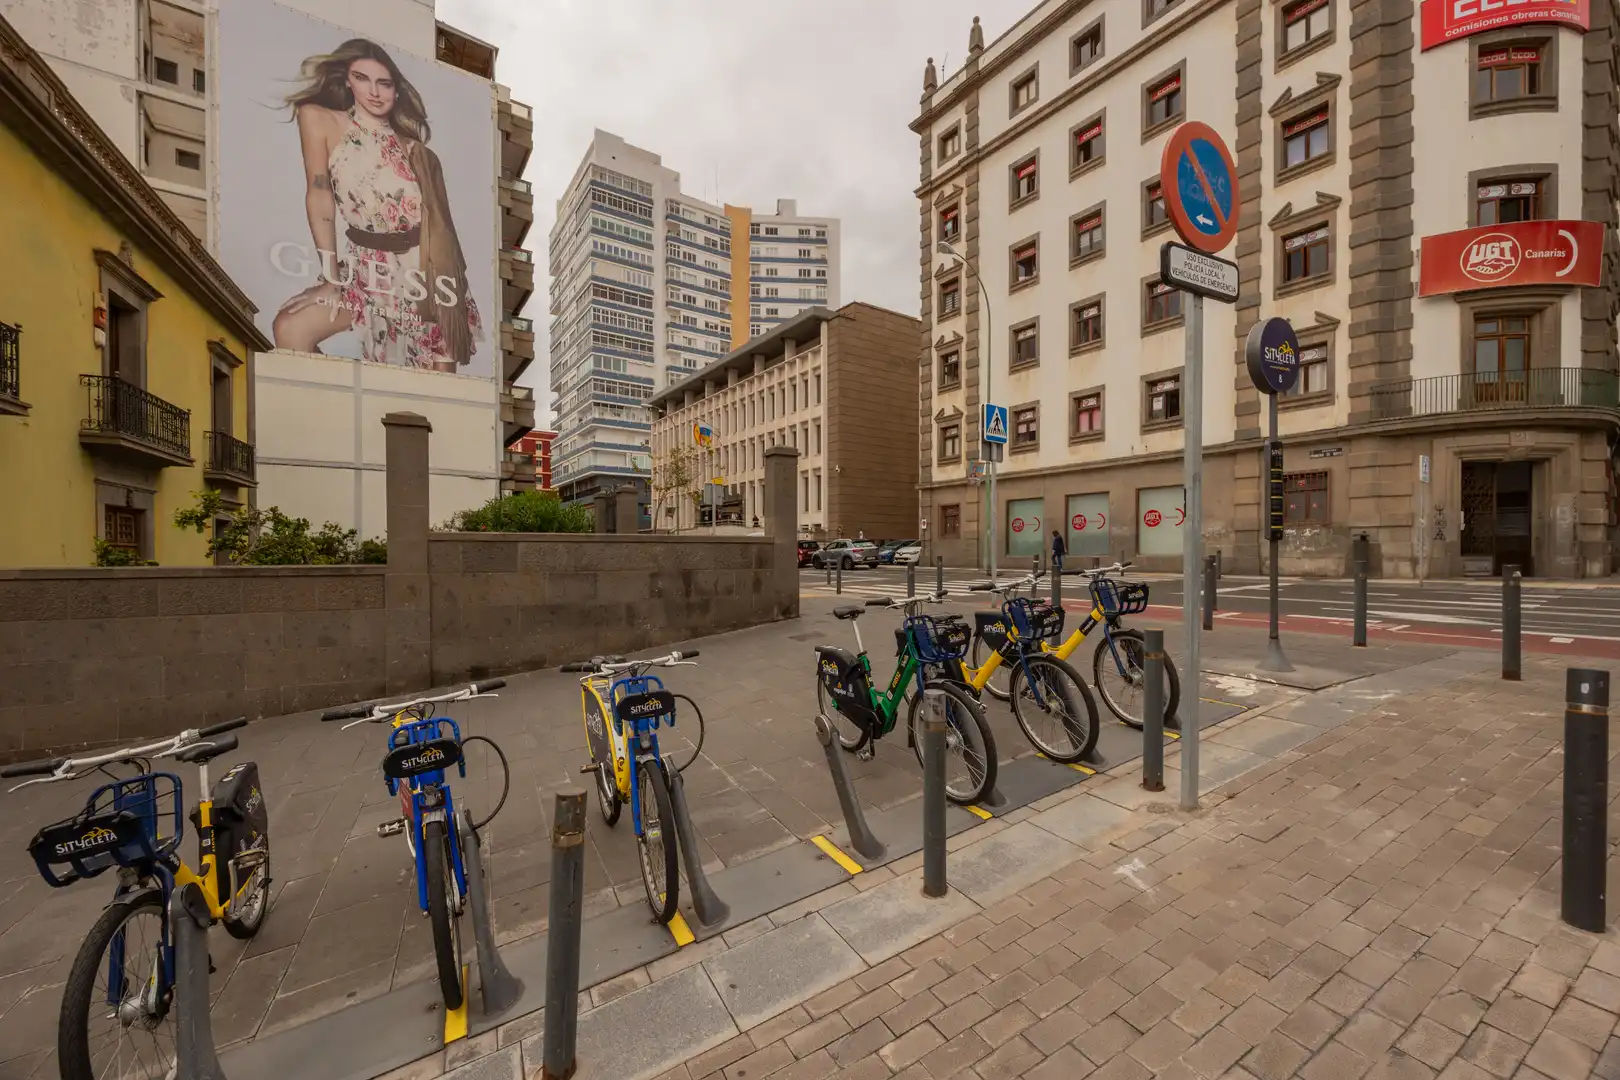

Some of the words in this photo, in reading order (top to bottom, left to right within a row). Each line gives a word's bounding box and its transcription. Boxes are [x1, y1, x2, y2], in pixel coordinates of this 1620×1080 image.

[1445, 16, 1508, 37] comisiones
[1512, 11, 1548, 21] obreras
[1551, 9, 1581, 21] Canarias
[1470, 240, 1513, 263] UGT
[1525, 248, 1567, 260] Canarias
[1186, 252, 1197, 263] USO
[1197, 255, 1224, 272] EXCLUSIVO
[270, 241, 458, 308] GUESS
[1204, 267, 1220, 280] LOCAL
[1199, 276, 1207, 285] DE
[1207, 279, 1237, 294] EMERGENCIA
[316, 296, 362, 313] CHIARA
[1278, 374, 1283, 383] 8
